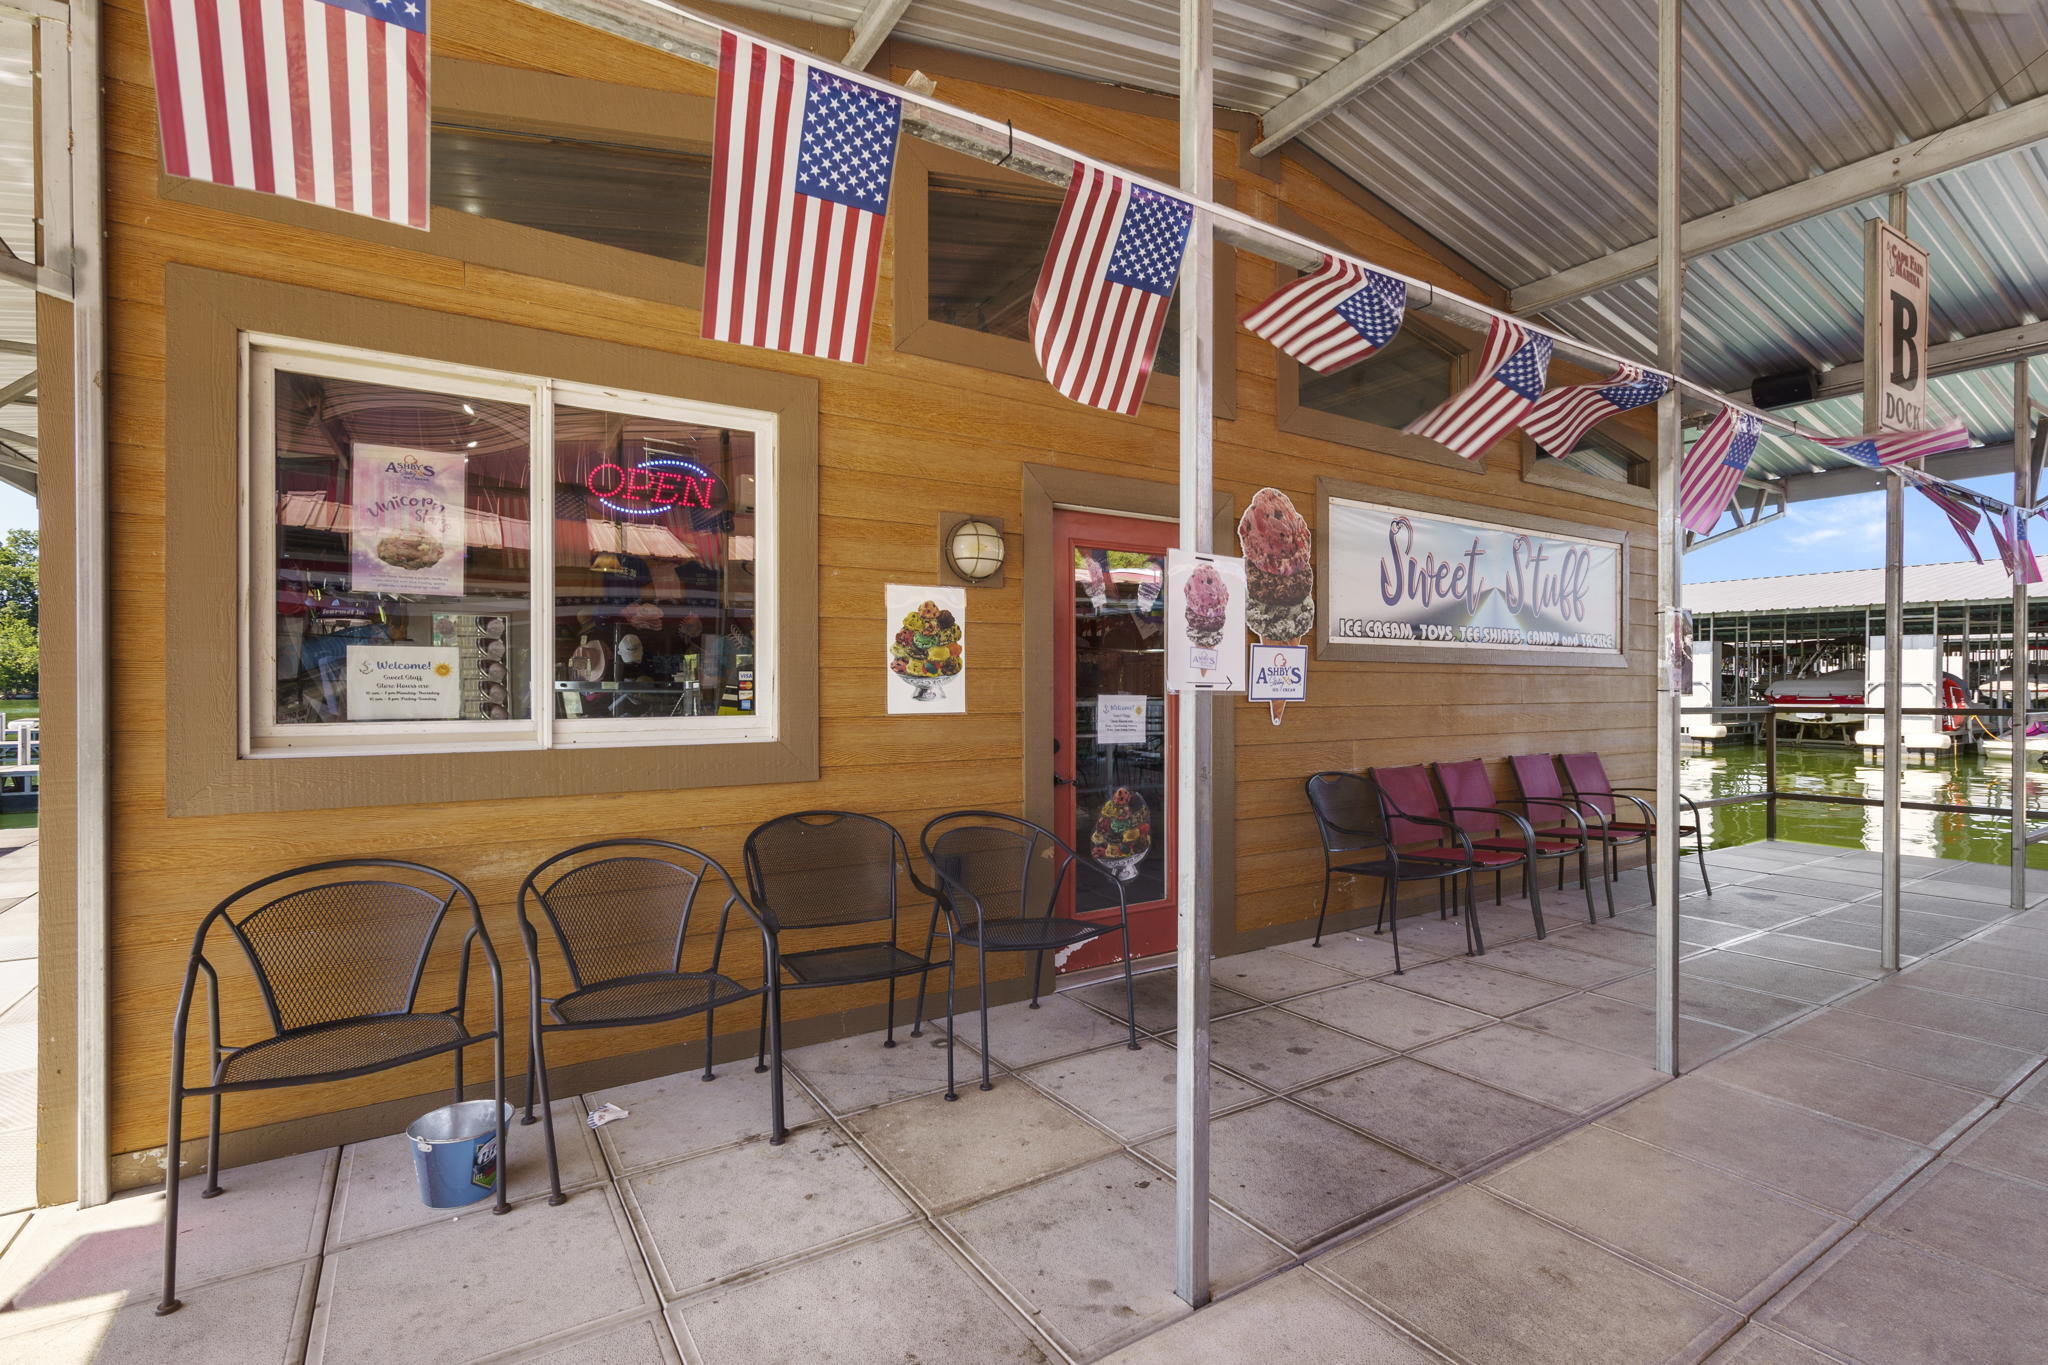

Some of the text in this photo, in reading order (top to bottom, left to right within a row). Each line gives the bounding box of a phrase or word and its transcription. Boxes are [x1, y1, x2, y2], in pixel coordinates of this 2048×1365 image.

[1896, 261, 1920, 289] MARINA
[1890, 289, 1919, 391] B
[1886, 392, 1921, 431] DOCK
[385, 461, 435, 477] ASHBY'S
[588, 463, 716, 509] OPEN
[367, 496, 445, 518] Unicorn
[1380, 516, 1591, 622] Sweet Stuff
[1339, 618, 1613, 648] ICE CREAM, TOYS, TEE SHIRTS, CANDY and TACKLE
[376, 661, 431, 670] Welcome!
[1256, 666, 1302, 684] ASHBY'S
